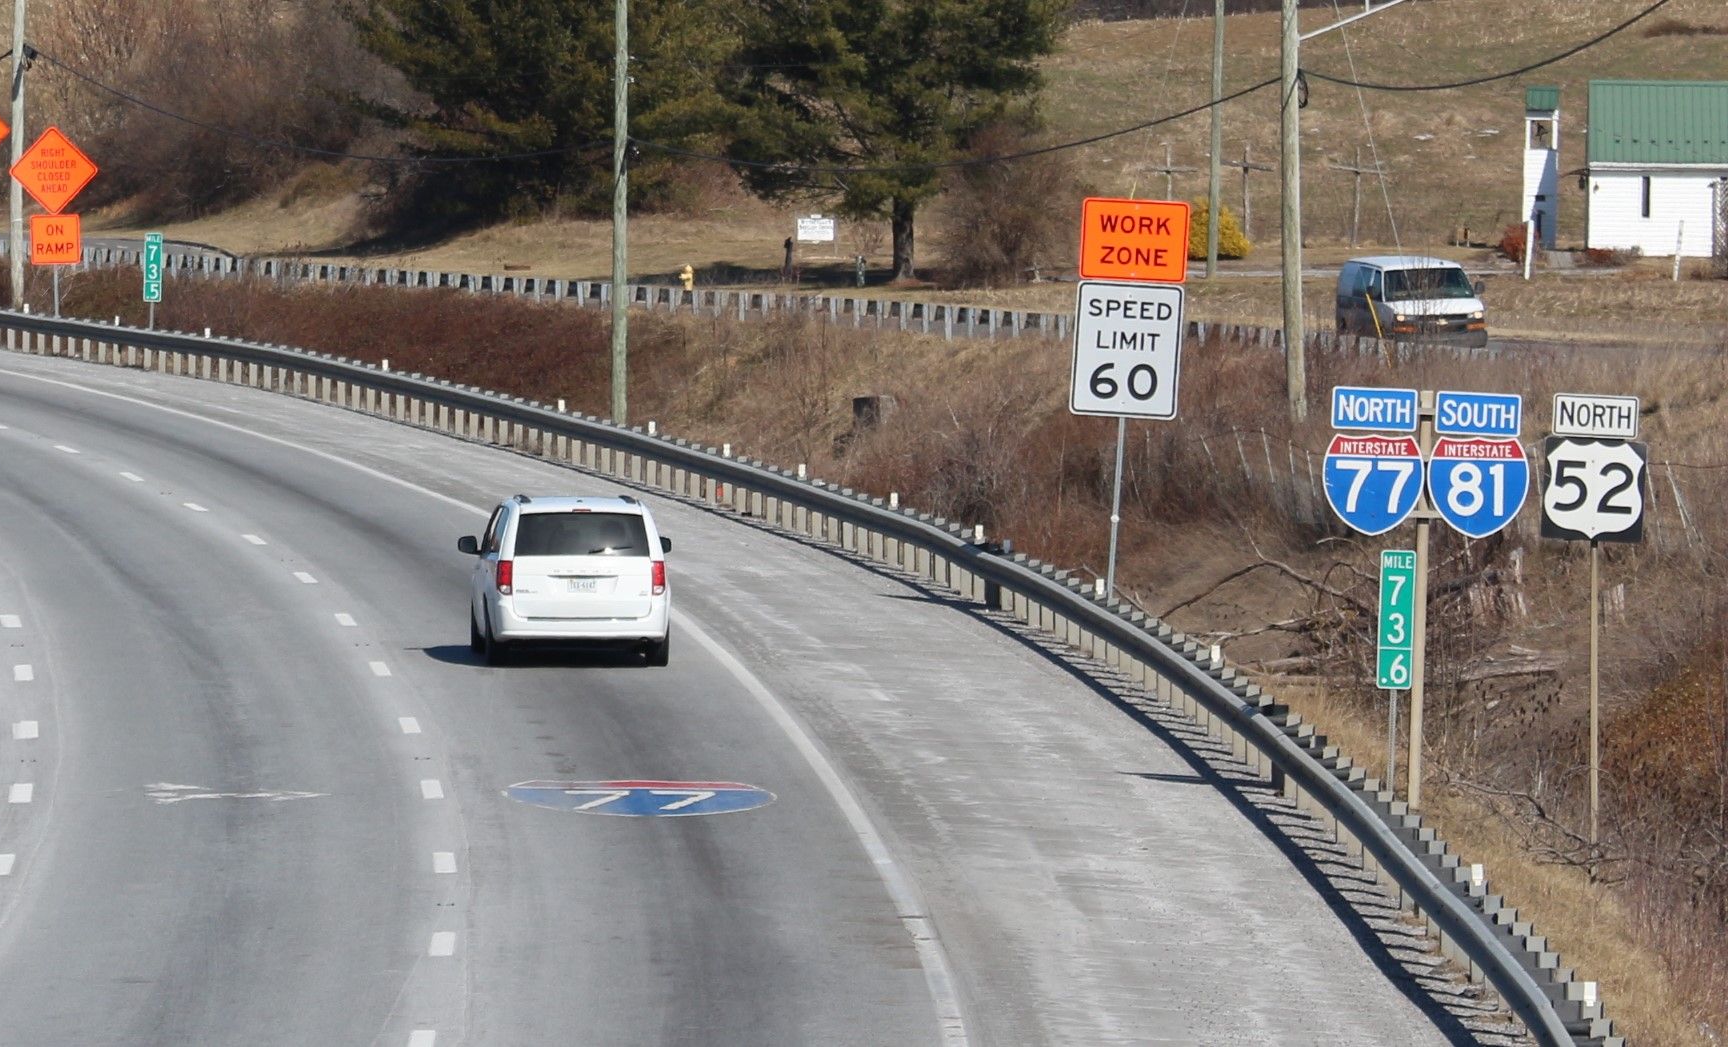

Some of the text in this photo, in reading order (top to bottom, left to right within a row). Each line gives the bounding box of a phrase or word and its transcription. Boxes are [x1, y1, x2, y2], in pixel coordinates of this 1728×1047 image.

[41, 148, 65, 157] RIGHT
[31, 160, 76, 170] SHOULDER
[37, 172, 70, 181] CLOSED
[41, 184, 68, 193] AHEAD
[46, 224, 64, 236] ON
[1100, 214, 1171, 236] WORK
[146, 234, 161, 243] MILE
[36, 243, 74, 255] RAMP
[1100, 246, 1168, 266] ZONE
[1088, 299, 1172, 320] SPEED
[1096, 330, 1160, 352] LIMIT
[1090, 363, 1158, 400] 60
[1338, 394, 1410, 424] NORTH
[1441, 399, 1515, 430] SOUTH
[1560, 401, 1632, 430] NORTH
[1340, 441, 1408, 456] INTERSTATE
[1444, 444, 1512, 458] INTERSTATE
[1336, 460, 1414, 514] 77
[1447, 462, 1504, 516] 81
[1552, 460, 1634, 515] 52
[1384, 556, 1413, 569] MILE
[564, 790, 716, 810] 77
